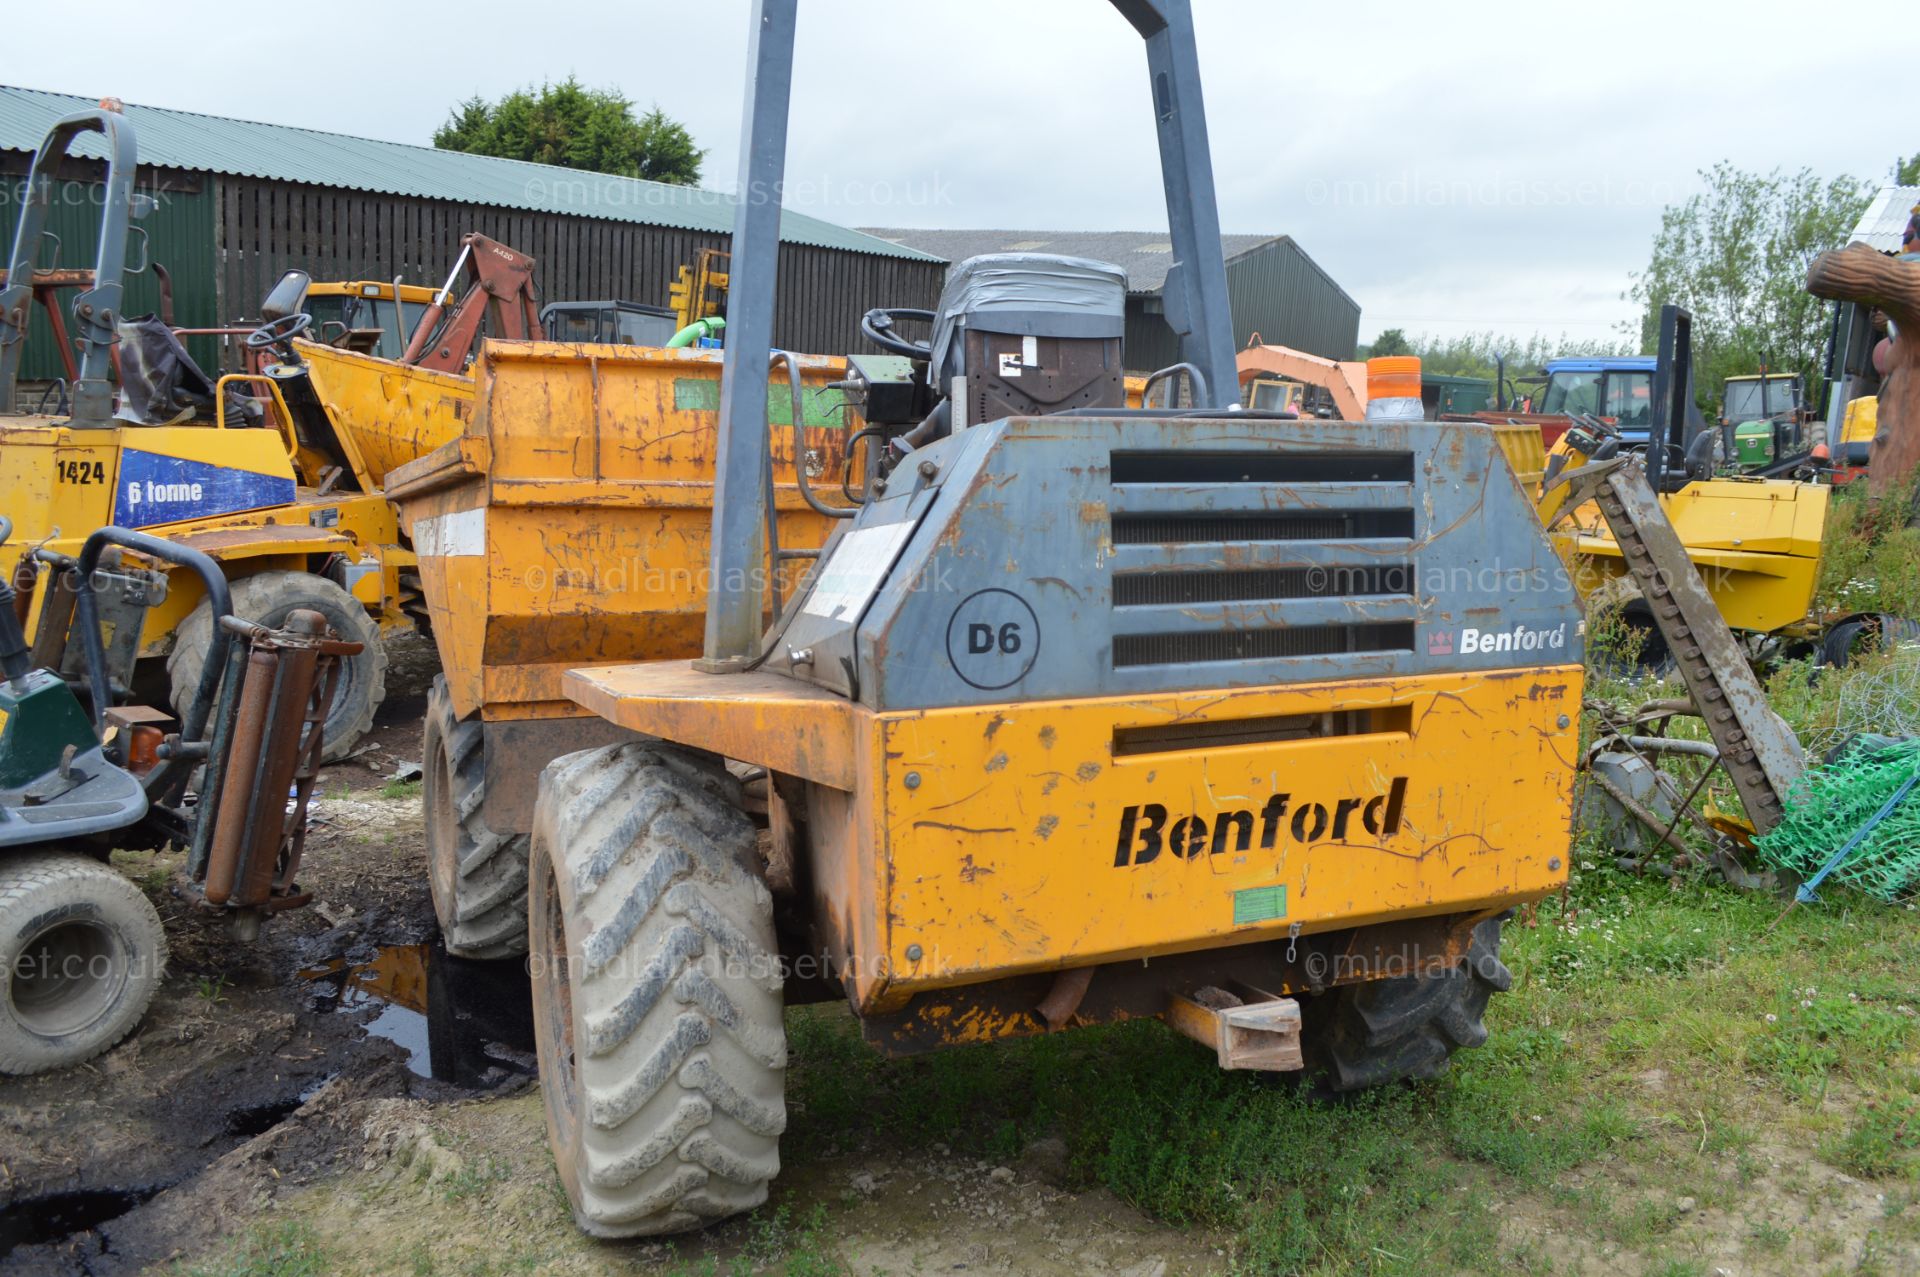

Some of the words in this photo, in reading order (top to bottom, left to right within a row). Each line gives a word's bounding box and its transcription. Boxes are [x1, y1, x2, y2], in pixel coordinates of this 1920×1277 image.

[57, 460, 104, 484] 1424
[128, 481, 142, 503] 6
[147, 481, 203, 502] tonne
[968, 622, 1021, 654] D6
[1459, 622, 1566, 654] Benford
[1113, 776, 1408, 868] Benford
